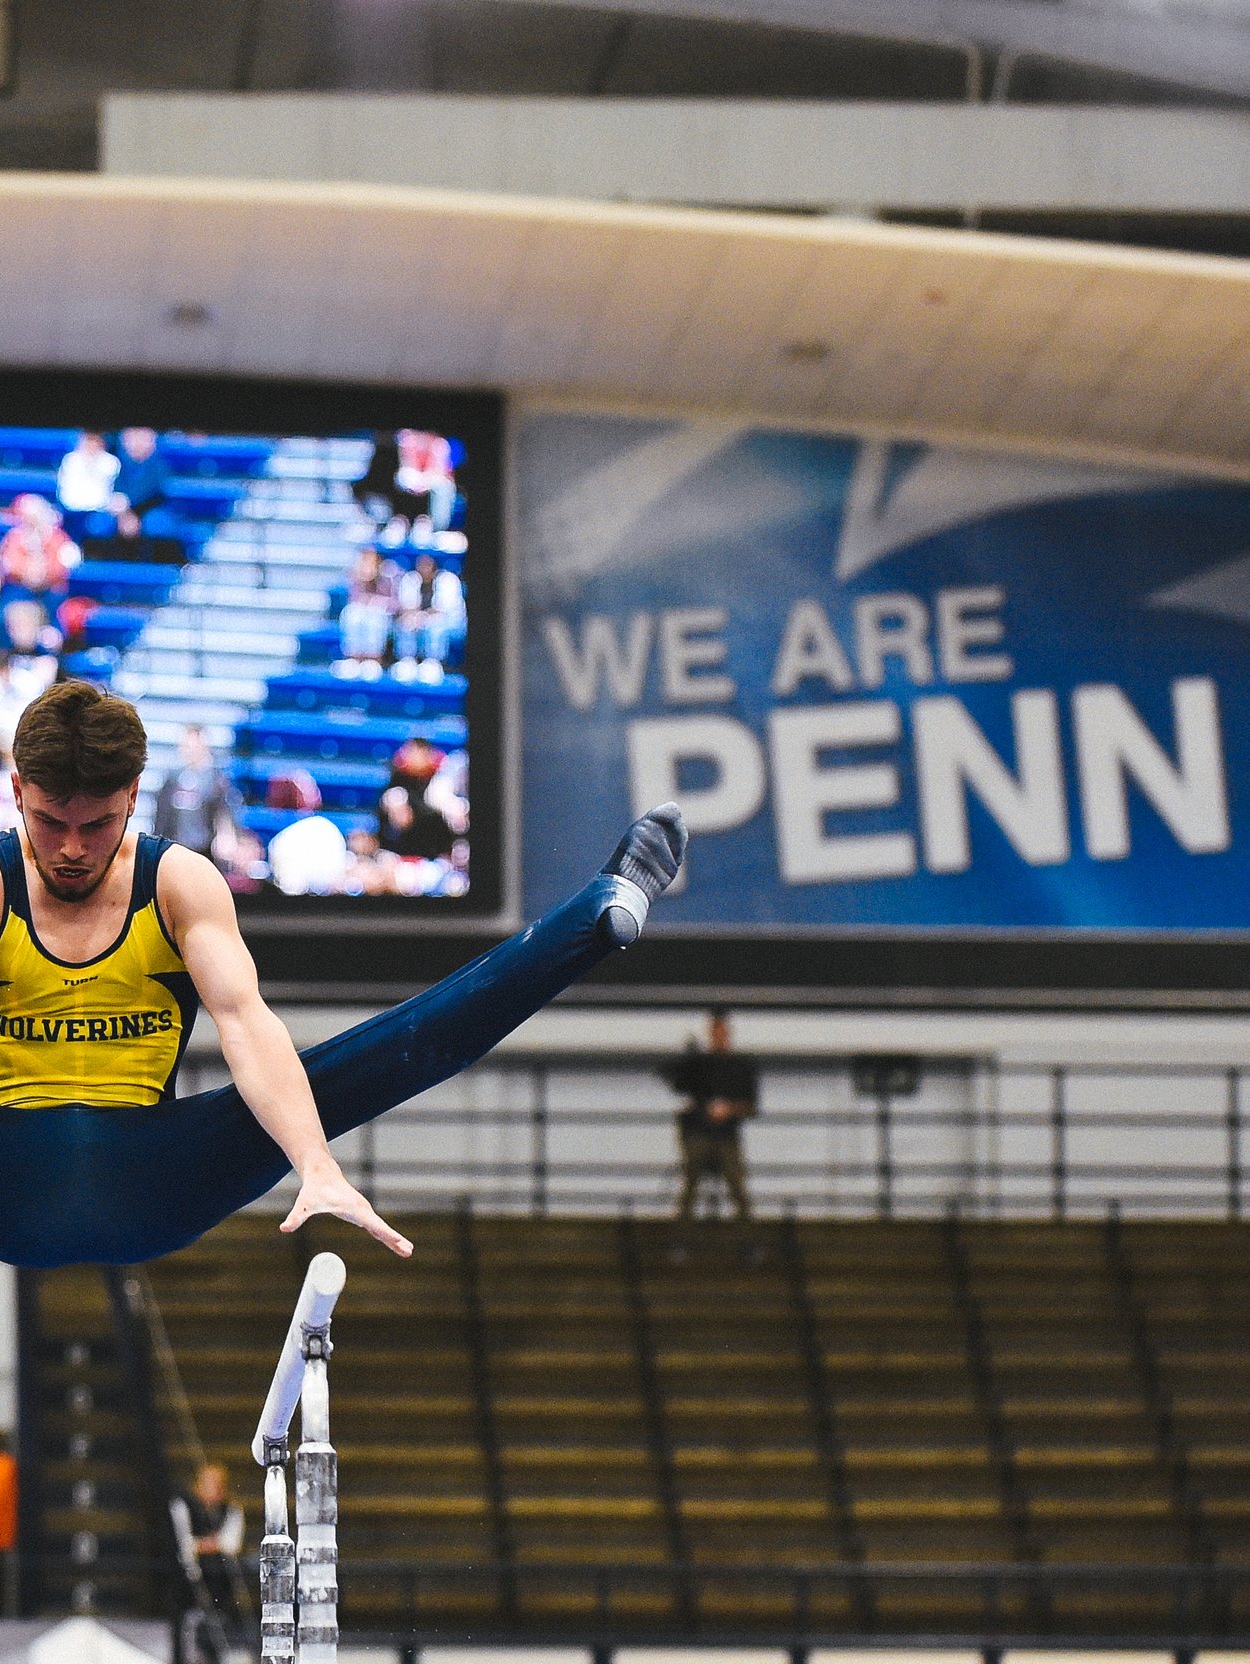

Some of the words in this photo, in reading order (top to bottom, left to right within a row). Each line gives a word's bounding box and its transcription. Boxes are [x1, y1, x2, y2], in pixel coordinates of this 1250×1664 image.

[545, 609, 735, 710] WE
[773, 586, 1012, 696] ARE
[626, 676, 1231, 894] PENN
